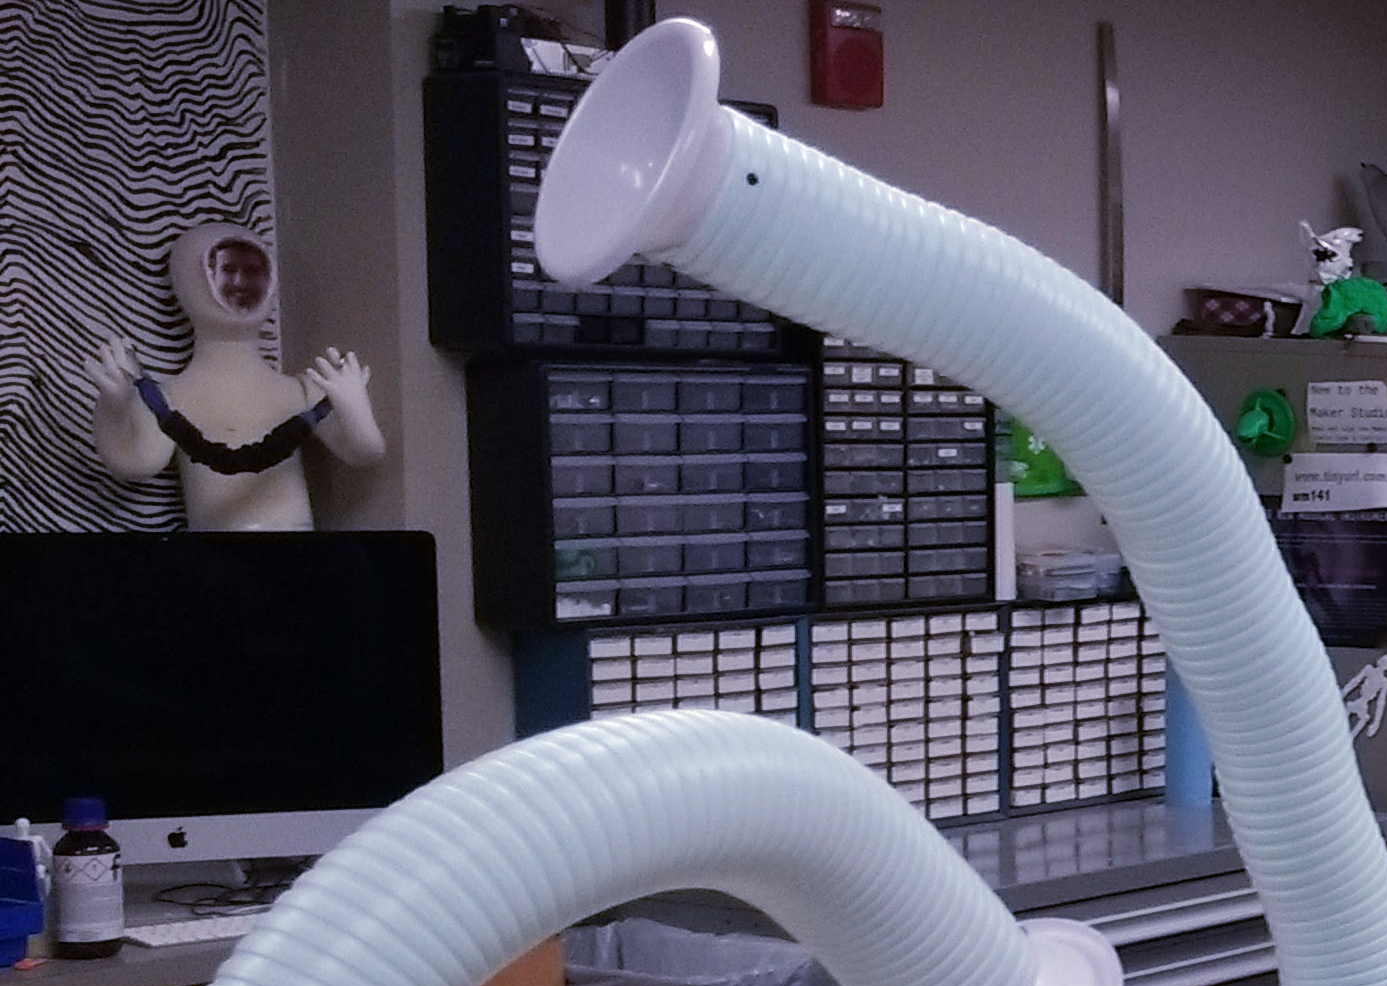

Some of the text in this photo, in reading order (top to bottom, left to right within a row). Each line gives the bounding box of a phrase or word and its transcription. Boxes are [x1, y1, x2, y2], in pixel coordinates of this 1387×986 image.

[1338, 386, 1351, 395] to
[1360, 386, 1379, 395] the
[1310, 406, 1344, 418] Maker
